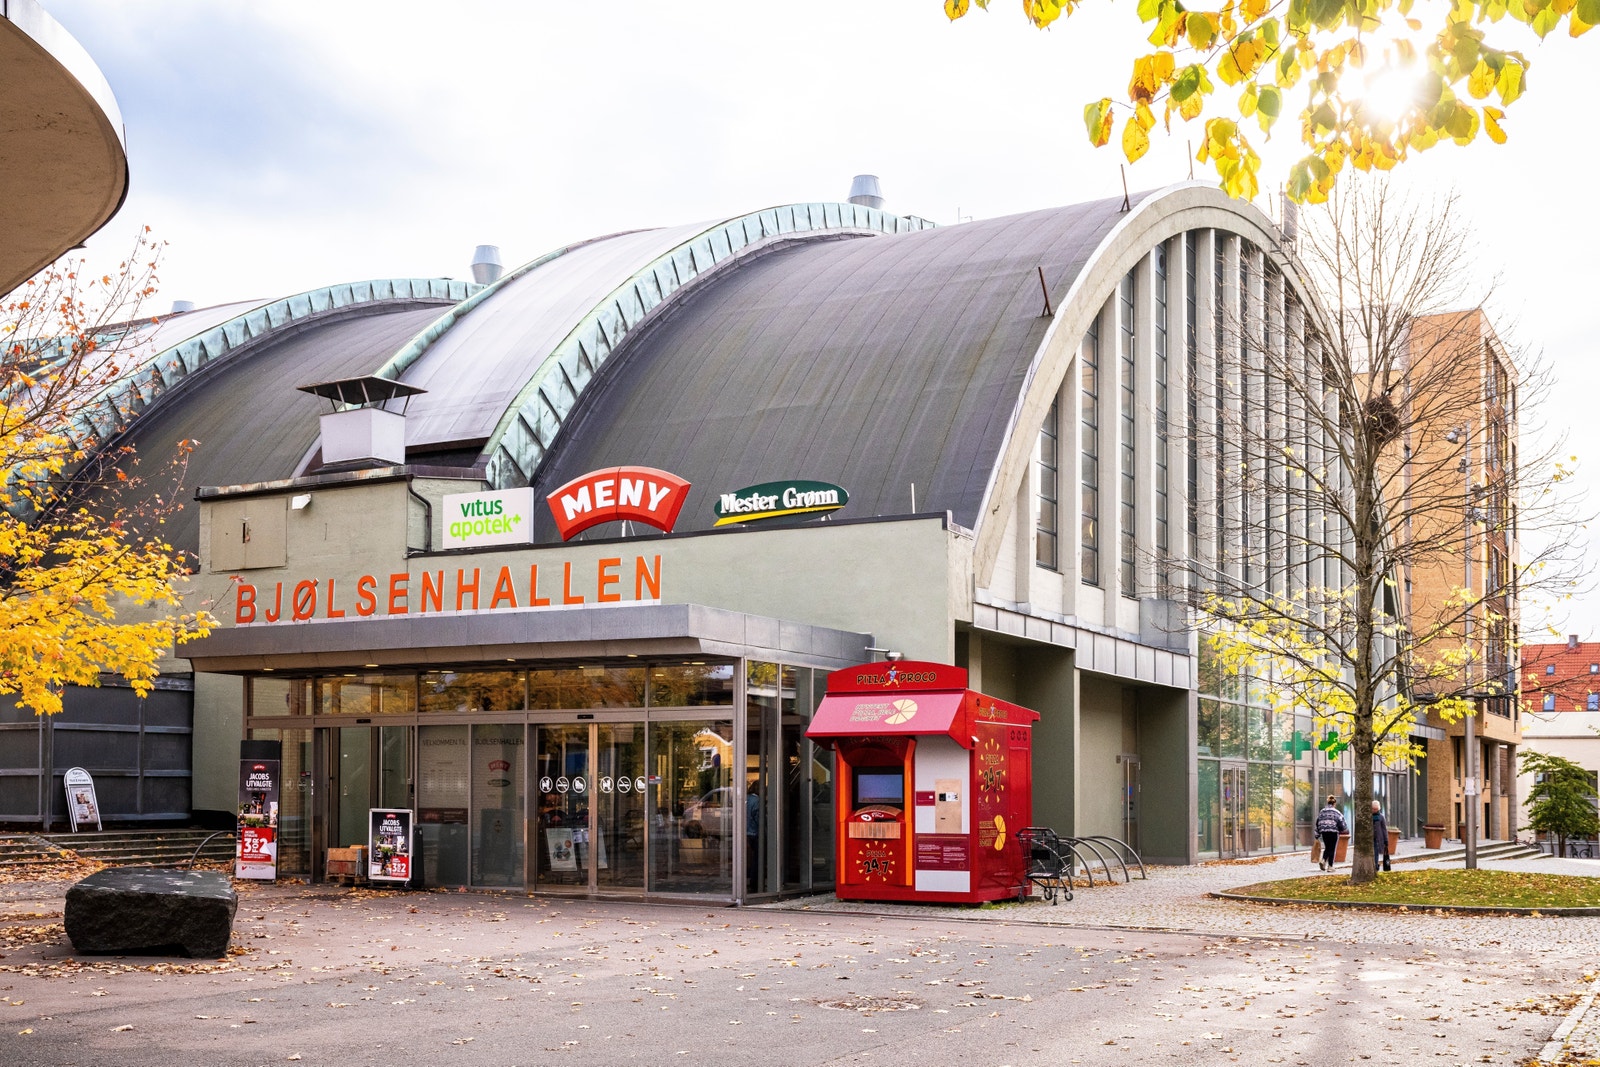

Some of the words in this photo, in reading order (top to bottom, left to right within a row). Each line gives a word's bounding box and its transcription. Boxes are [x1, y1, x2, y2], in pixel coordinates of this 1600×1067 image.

[560, 478, 671, 521] MENY
[720, 492, 779, 514] Mester
[782, 487, 840, 509] Grønn
[460, 498, 503, 518] vitus
[235, 554, 662, 624] BJØLSENHALLEN
[856, 673, 886, 685] PIZZA
[899, 671, 936, 684] PROCO
[249, 772, 270, 780] JACOBS
[245, 780, 273, 788] UTVALGTE
[379, 825, 403, 833] UTVALGTE
[243, 837, 252, 853] 3
[251, 838, 259, 853] FOR
[259, 837, 269, 854] 2
[392, 862, 397, 873] 3
[401, 863, 406, 873] 2
